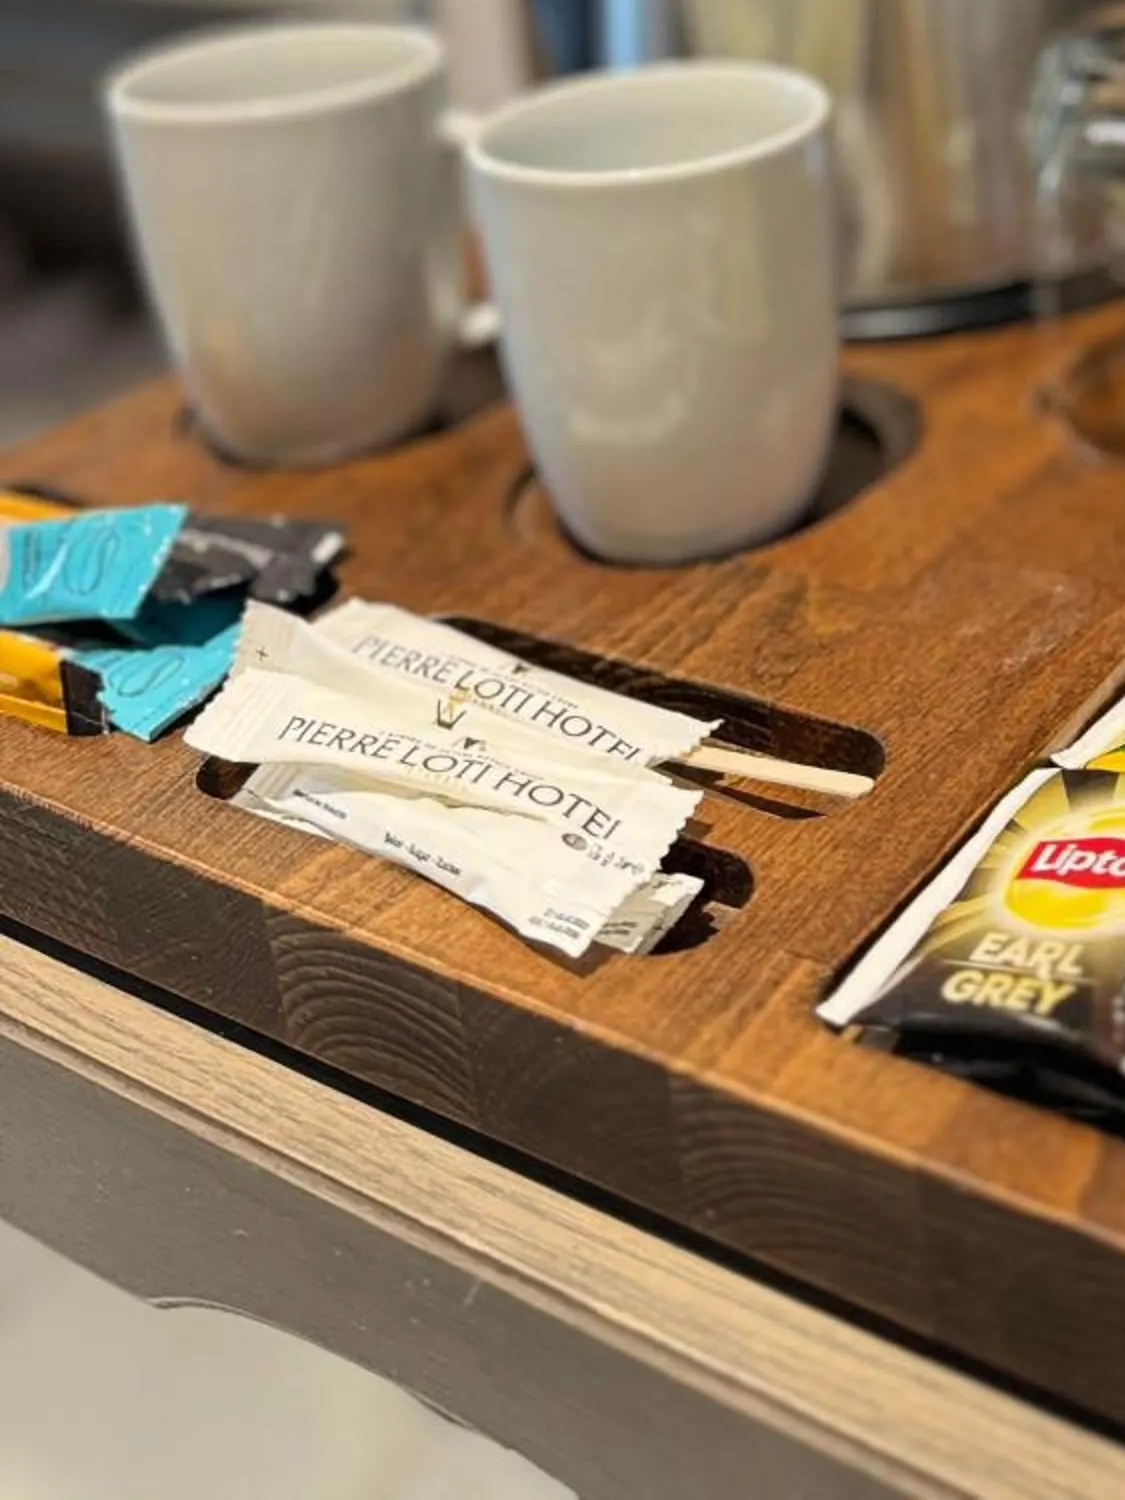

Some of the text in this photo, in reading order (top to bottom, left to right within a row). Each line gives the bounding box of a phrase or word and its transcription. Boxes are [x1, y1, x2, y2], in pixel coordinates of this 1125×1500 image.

[352, 635, 457, 684] PIERRE
[453, 669, 532, 714] LOTI
[277, 715, 400, 760] PIERRE
[398, 745, 493, 783] LOTI
[969, 931, 1085, 976] EARL
[940, 970, 1077, 1016] GREY
